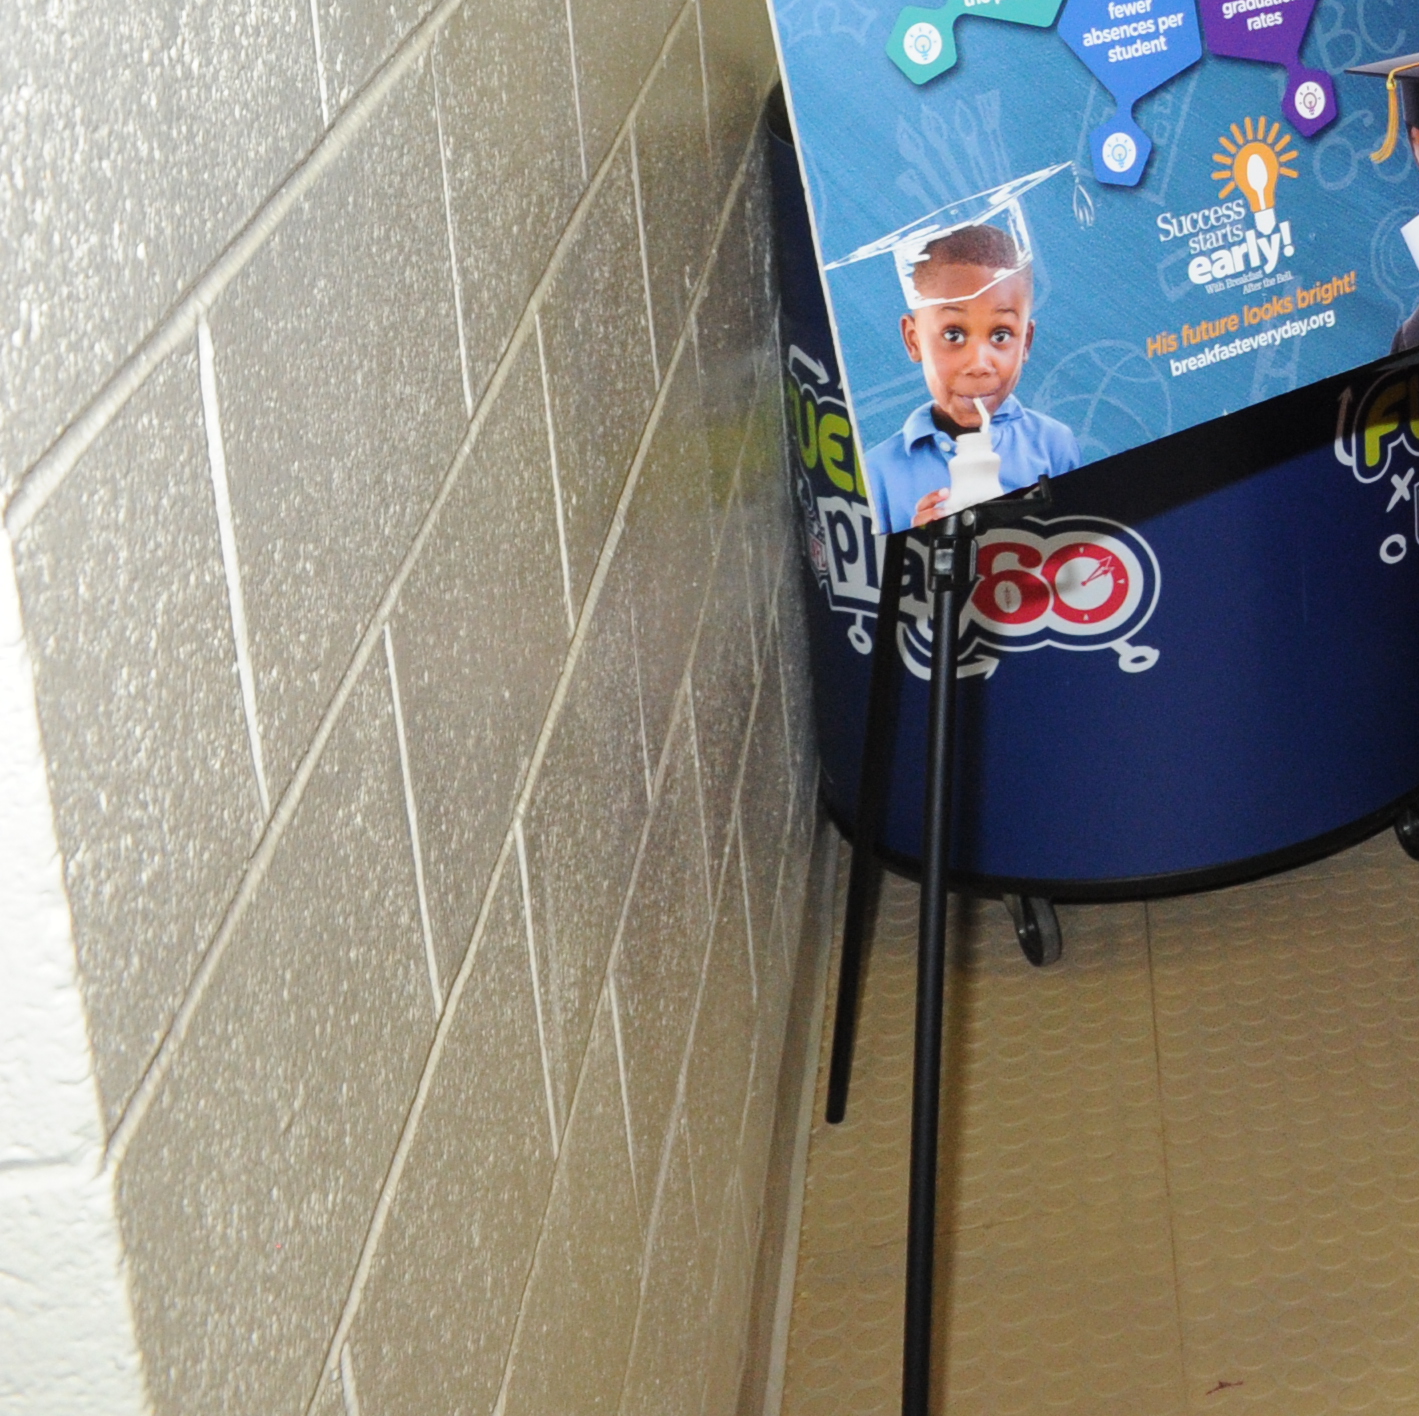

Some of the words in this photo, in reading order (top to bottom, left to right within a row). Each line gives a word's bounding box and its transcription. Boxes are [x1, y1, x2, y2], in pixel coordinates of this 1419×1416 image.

[1082, 17, 1156, 48] absences
[1156, 12, 1184, 36] per
[1246, 11, 1283, 32] rates
[1107, 34, 1168, 64] student
[1157, 199, 1246, 242] Success
[1188, 223, 1244, 254] starts
[1188, 220, 1295, 285] early!
[1146, 330, 1178, 359] His
[1182, 313, 1240, 348] future
[1243, 293, 1294, 327] looks
[1296, 270, 1357, 312] bright!
[1169, 309, 1336, 377] breakfasteveryday.org
[972, 542, 1129, 623] 60
